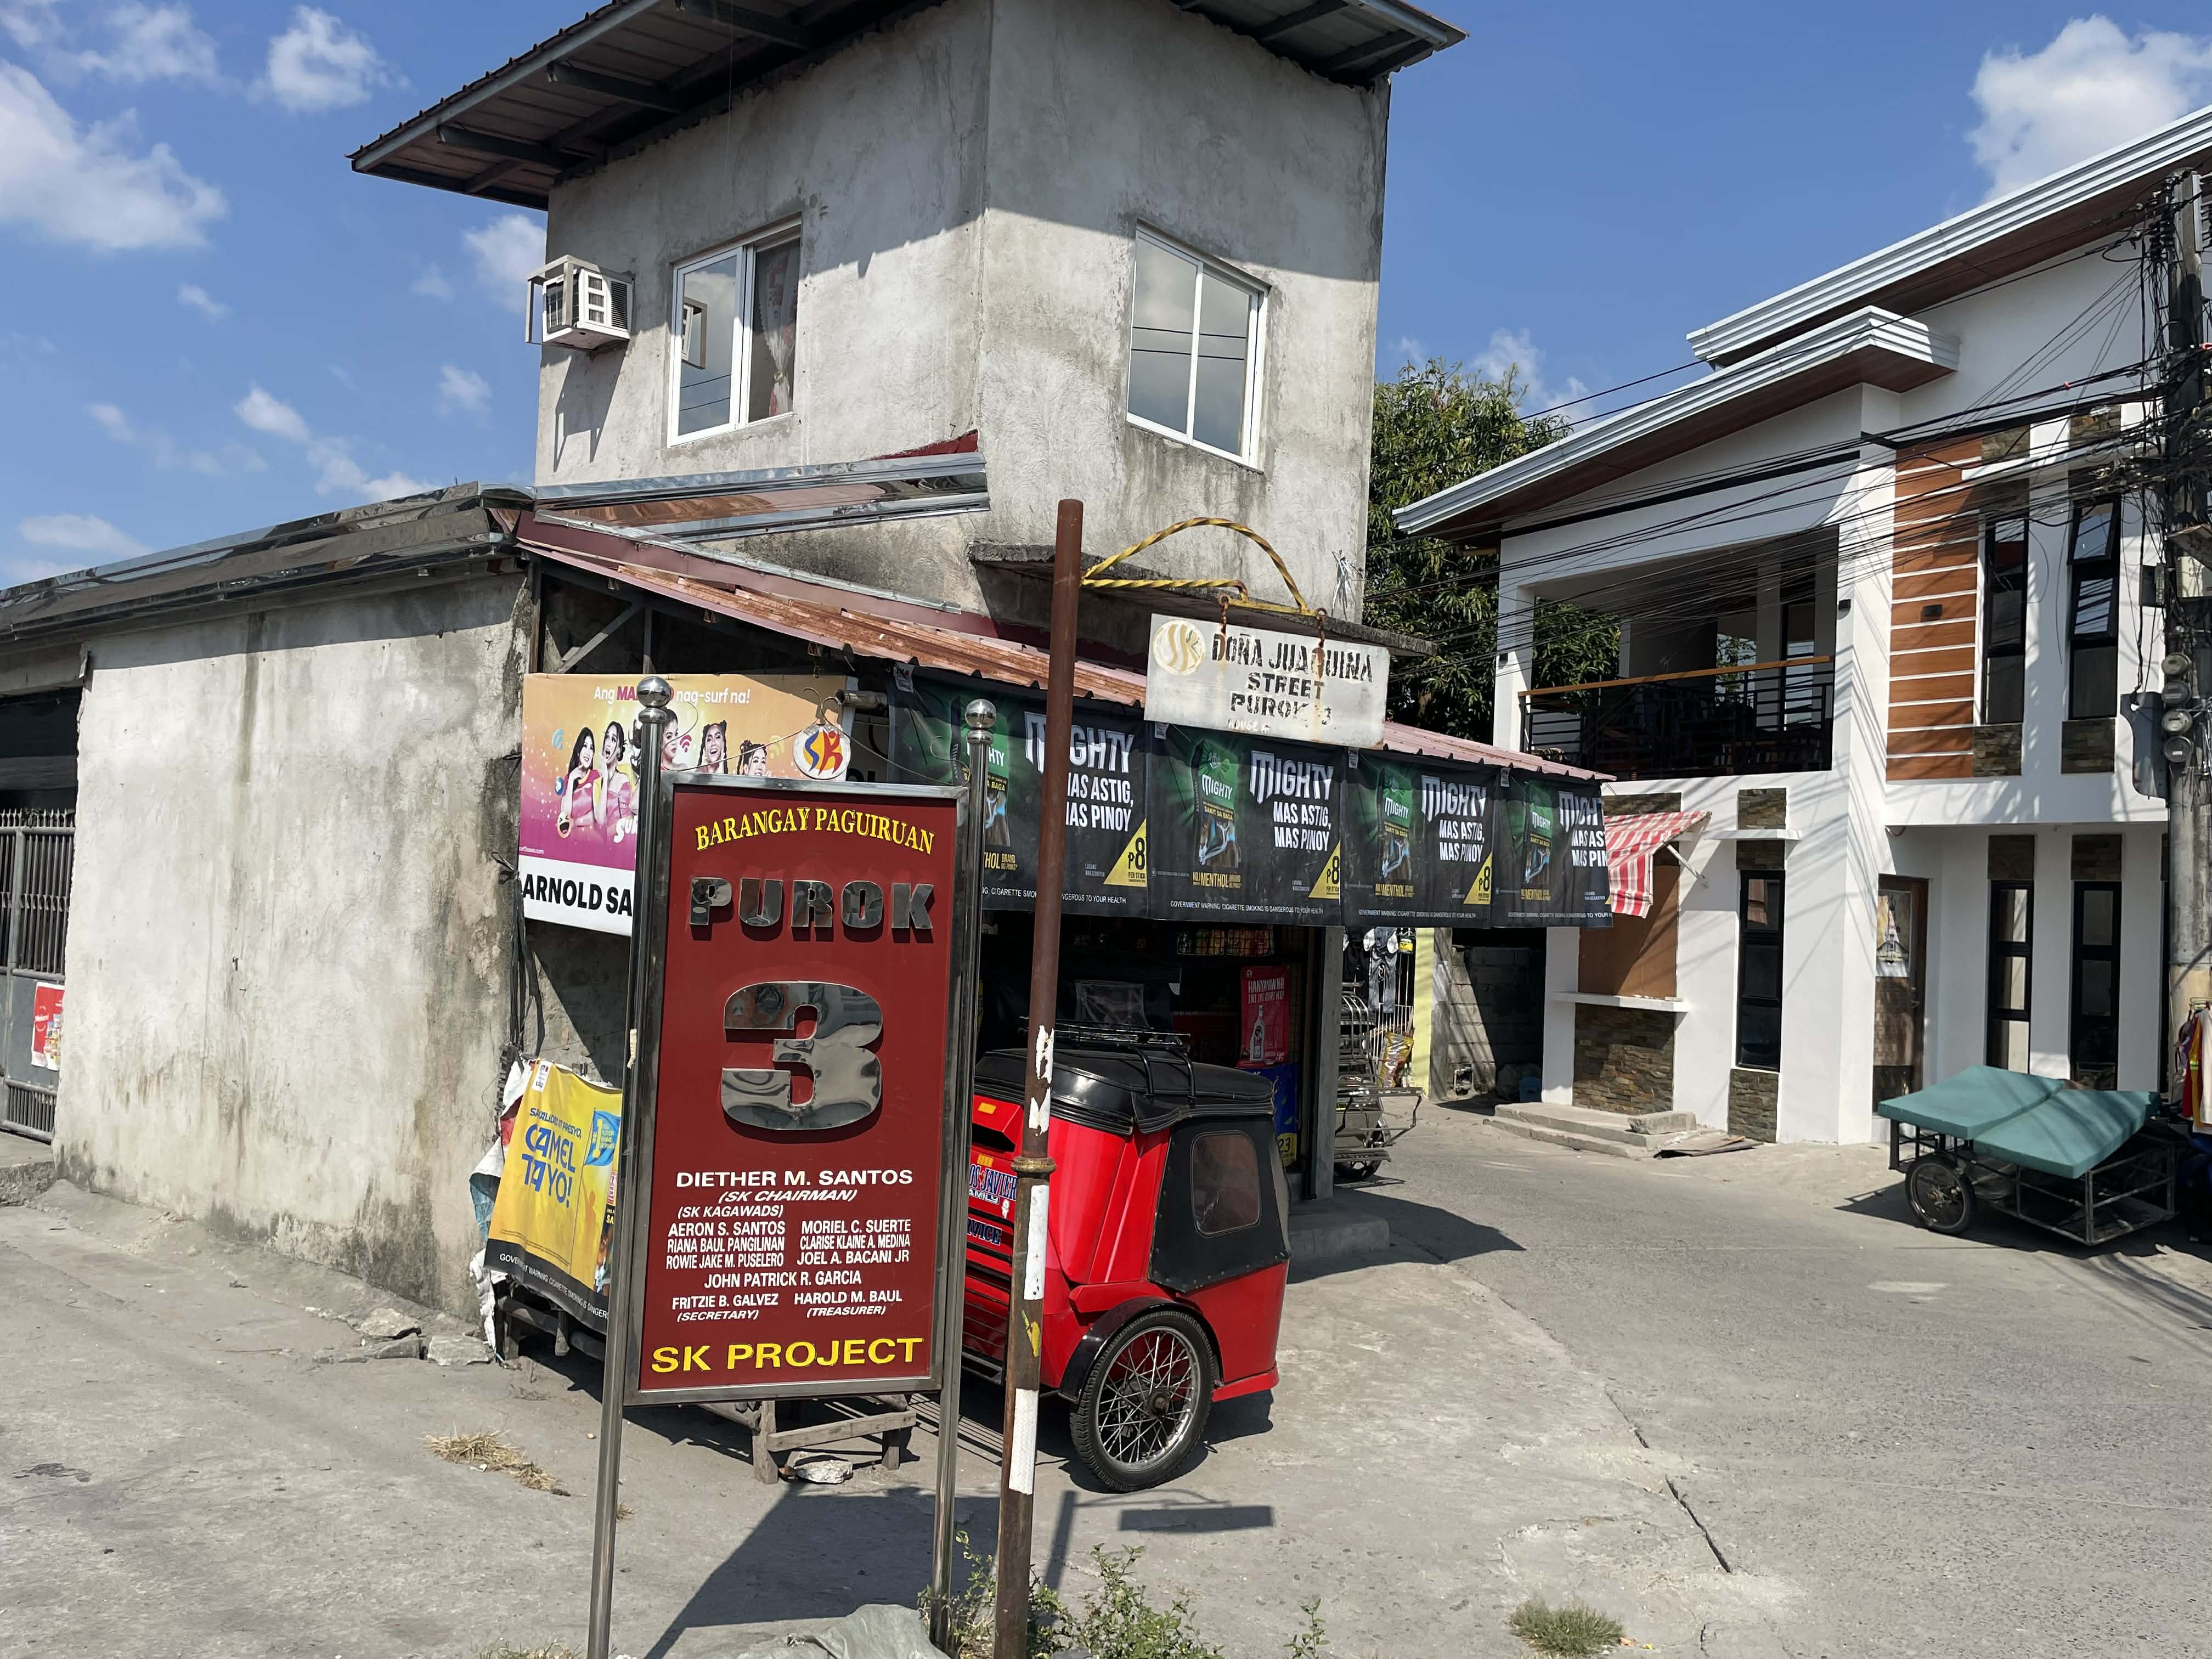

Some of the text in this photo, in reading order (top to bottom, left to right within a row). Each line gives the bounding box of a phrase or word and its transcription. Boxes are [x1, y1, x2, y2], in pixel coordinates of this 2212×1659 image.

[1248, 672, 1325, 699] STREET
[594, 687, 614, 704] Ang
[676, 687, 728, 706] nag-surf
[730, 689, 751, 703] na!
[1231, 693, 1309, 718] PUROK
[1024, 711, 1135, 774] MGHTY
[1249, 750, 1334, 804] MIGHTY
[1068, 772, 1133, 808] AS ASTIG,
[1202, 774, 1233, 800] MIGHTY
[1385, 797, 1409, 819] MIGHTY
[1421, 775, 1486, 822] MIGHTY
[1066, 802, 1131, 832] AS PINOY
[1273, 801, 1331, 830] MAS ASTIG,
[1532, 812, 1550, 830] MIGHTY
[695, 808, 935, 855] BARANGAY PAGUIRUAN
[1274, 826, 1330, 852] MAS PINOY
[1439, 820, 1485, 843] MAS ASTIG,
[1572, 830, 1588, 847] MAS
[1002, 853, 1015, 863] BRAND
[1440, 842, 1483, 862] MAS PINOY
[1572, 850, 1608, 867] MAS PIN
[1201, 872, 1229, 888] MENTHOL
[523, 874, 602, 910] ARNOLD
[991, 888, 1022, 897] CIGARETTE
[1062, 893, 1085, 901] NGEROUS
[1108, 896, 1126, 904] HEALTH
[689, 877, 935, 929] PUROK
[1171, 900, 1200, 909] GOVERNMENT
[720, 980, 883, 1130] 3
[526, 1124, 575, 1173] CAMEL
[676, 1169, 913, 1188] DIETHER M. SANTOS
[718, 1189, 857, 1204] (SK CHAIRMAN)
[678, 1205, 783, 1219] (SK KAGAWADS)
[668, 1221, 786, 1237] AERON S. SANTOS
[801, 1219, 911, 1234] MORIEL C. SUERTE
[667, 1237, 785, 1253] RIANA BAUL PANGILINAN
[800, 1234, 910, 1250] CLARISE KLAINE A. MEDINA
[666, 1252, 784, 1269] ROWIE JAKE M. PUSELERO
[797, 1249, 910, 1266] JOEL A. BACANI JR
[704, 1270, 862, 1289] JOHN PATRICK R. GARCIA
[672, 1293, 778, 1310] FRITZIE B. GALVEZ
[794, 1290, 902, 1305] HAROLD M. BAUL
[676, 1305, 887, 1323] (SECRETARY) (TREASURER)
[651, 1338, 924, 1374] SK PROJECT
